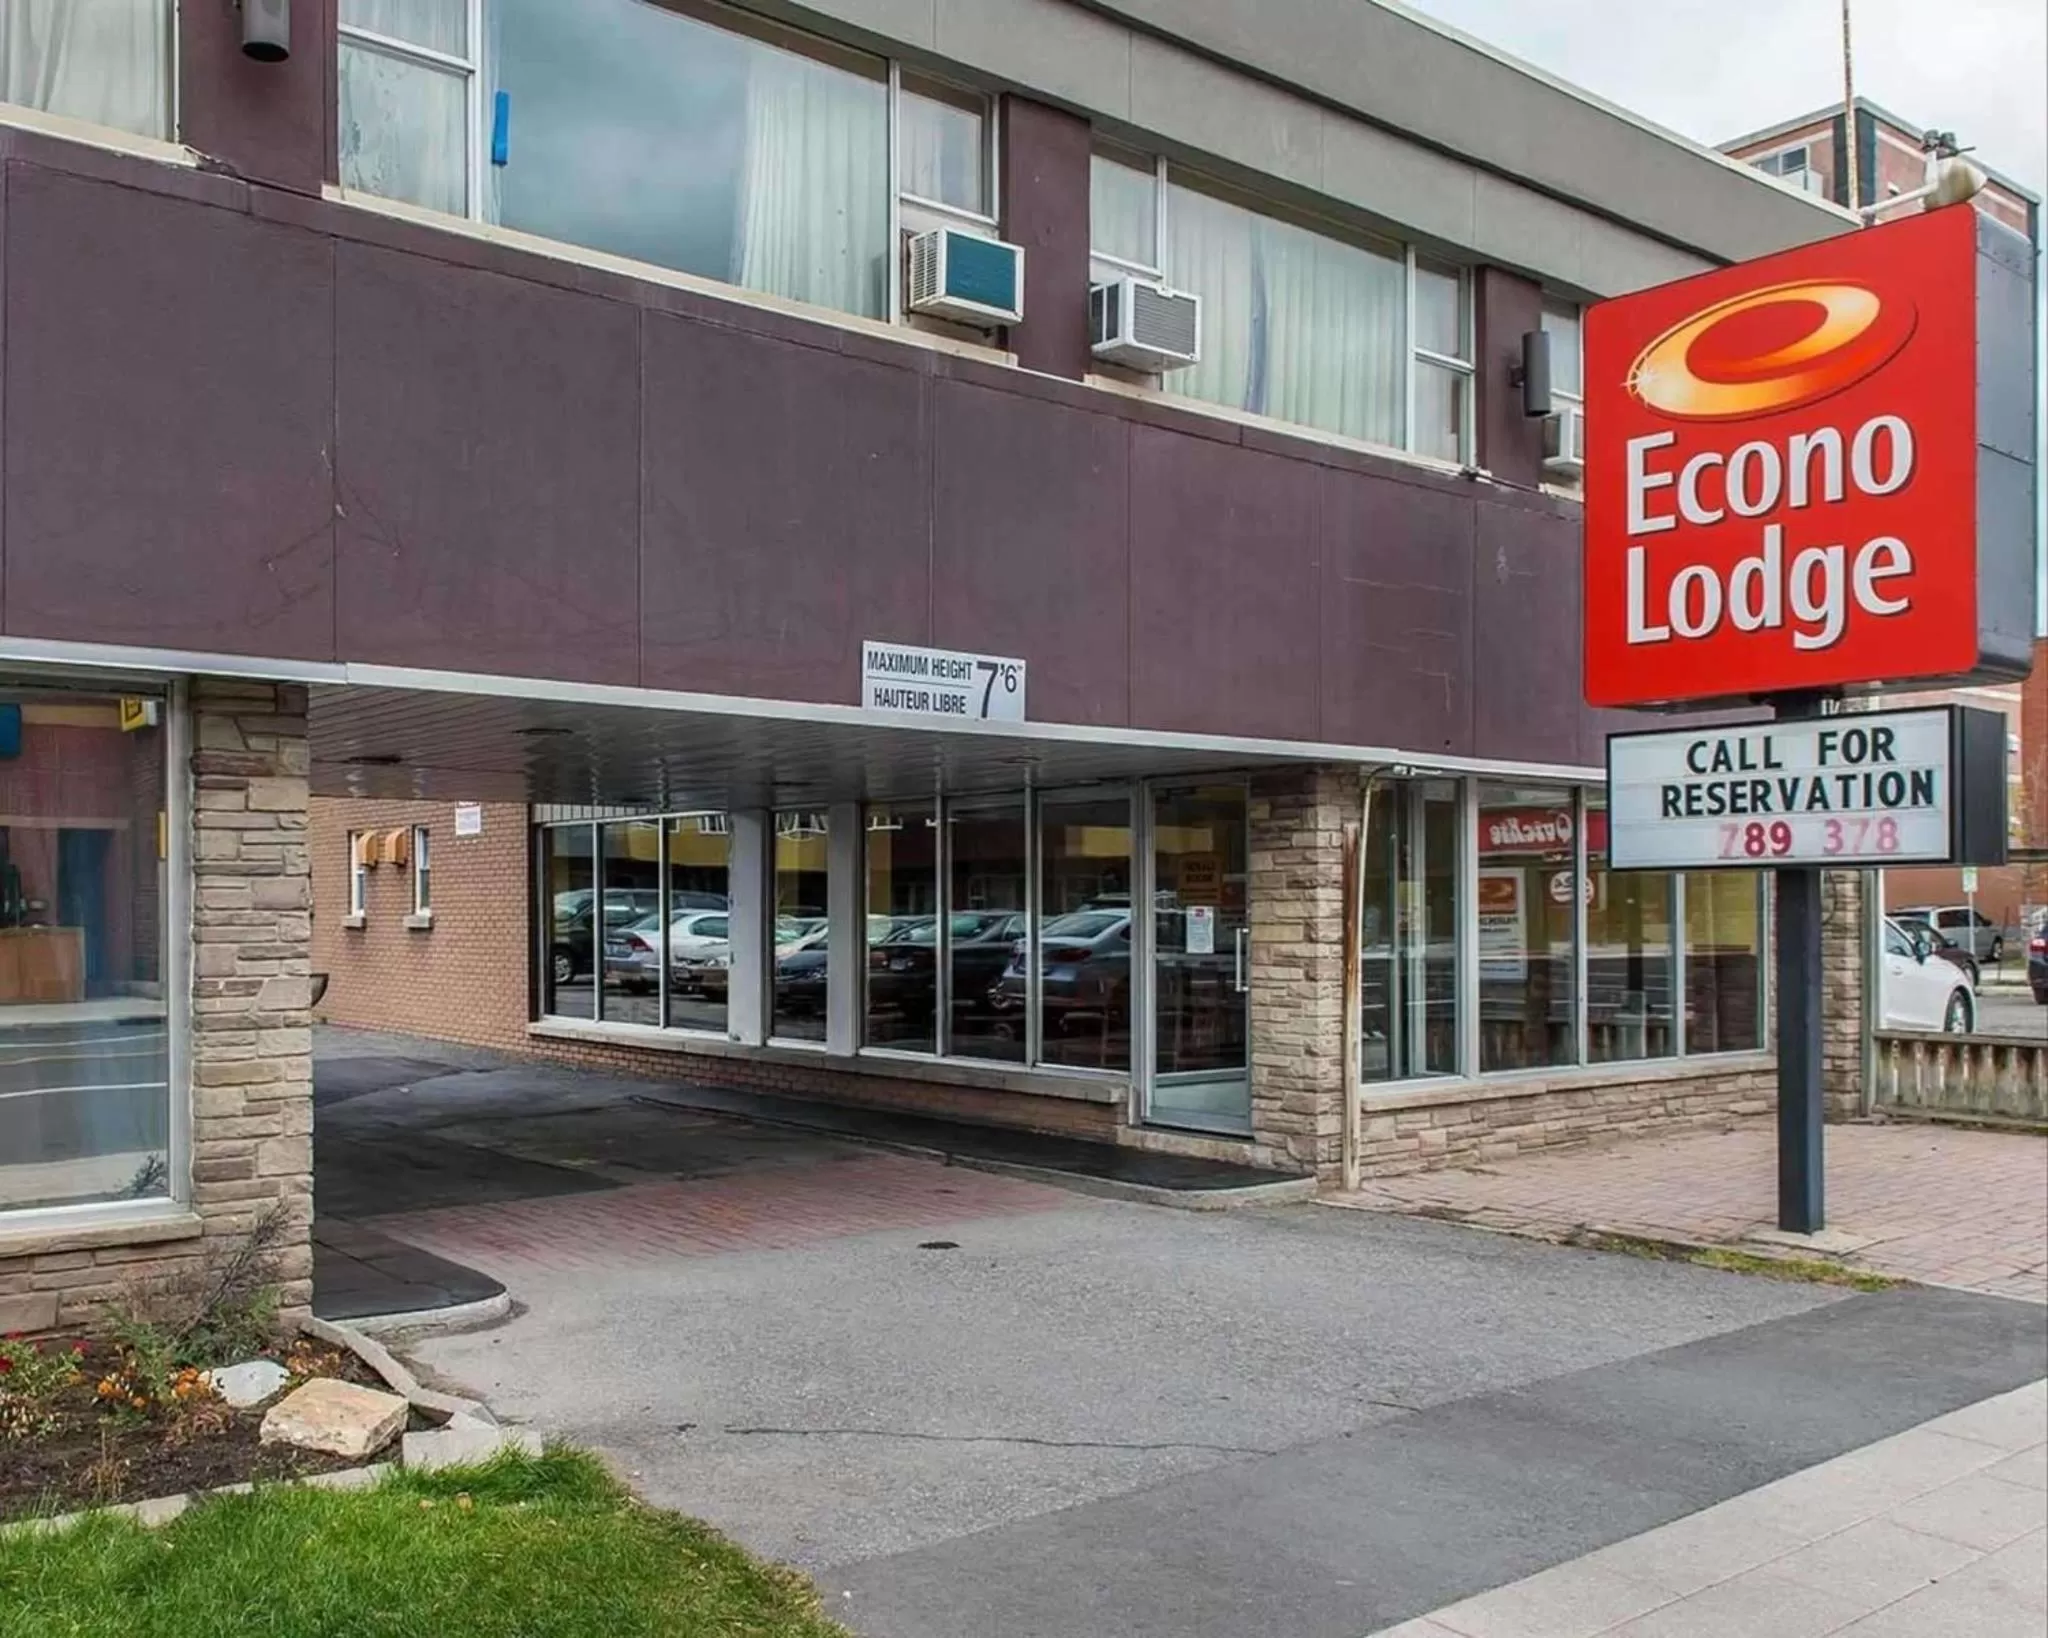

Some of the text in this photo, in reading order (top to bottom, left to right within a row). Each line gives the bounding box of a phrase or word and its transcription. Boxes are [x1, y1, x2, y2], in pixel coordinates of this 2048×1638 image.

[1626, 414, 1914, 535] Econo
[1626, 523, 1912, 650] Lodge
[867, 651, 973, 680] MAXIMUM HEIGHT
[874, 687, 966, 714] HAUTEUR LIBRE
[1686, 726, 1896, 774] CALL FOR
[1661, 768, 1935, 818] RESERVATION
[1720, 815, 1900, 858] 789 378
